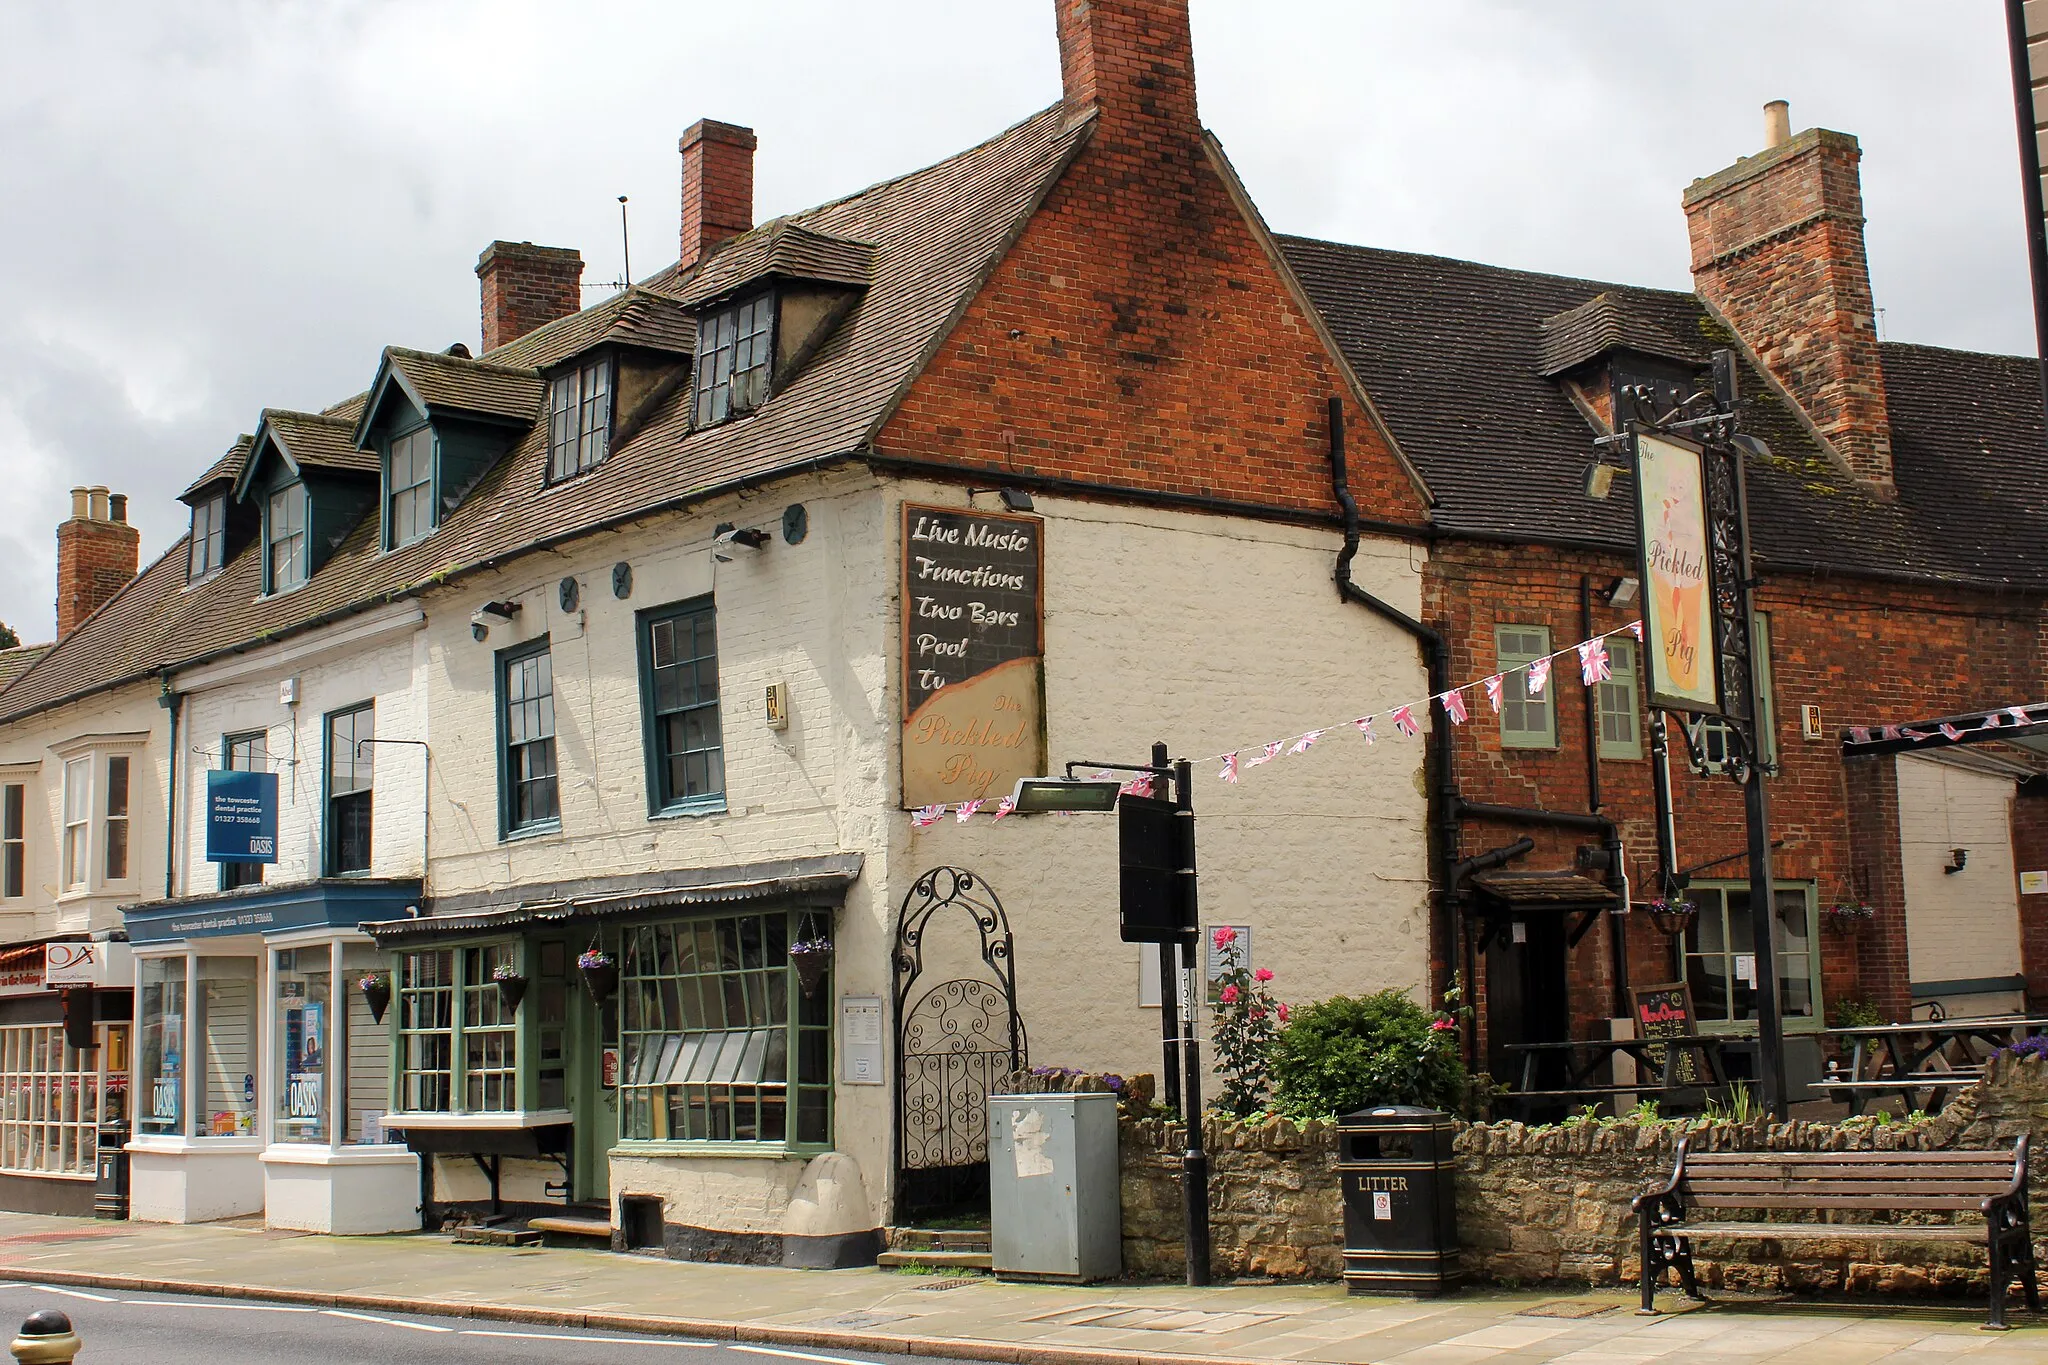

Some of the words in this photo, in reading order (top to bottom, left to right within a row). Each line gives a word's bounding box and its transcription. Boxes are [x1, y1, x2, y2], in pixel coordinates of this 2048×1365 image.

[1638, 440, 1655, 462] The
[911, 516, 960, 544] Live
[964, 523, 1029, 552] Music
[1646, 539, 1704, 581] Pickled
[915, 556, 1024, 591] Functions
[967, 602, 1019, 627] Bars
[916, 633, 969, 657] Pool
[1666, 627, 1695, 675] Pig
[992, 695, 1023, 712] The
[914, 713, 1028, 749] Pickled
[938, 753, 1003, 800] Pig
[214, 795, 227, 803] the
[227, 796, 260, 805] towcester
[214, 804, 236, 812] dental
[236, 806, 263, 814] practice
[250, 839, 273, 854] OASIS
[203, 917, 217, 929] dental
[218, 916, 237, 929] practice
[153, 1084, 175, 1117] OASIS
[290, 1082, 318, 1116] OASIS
[1358, 1176, 1409, 1191] LITTER
